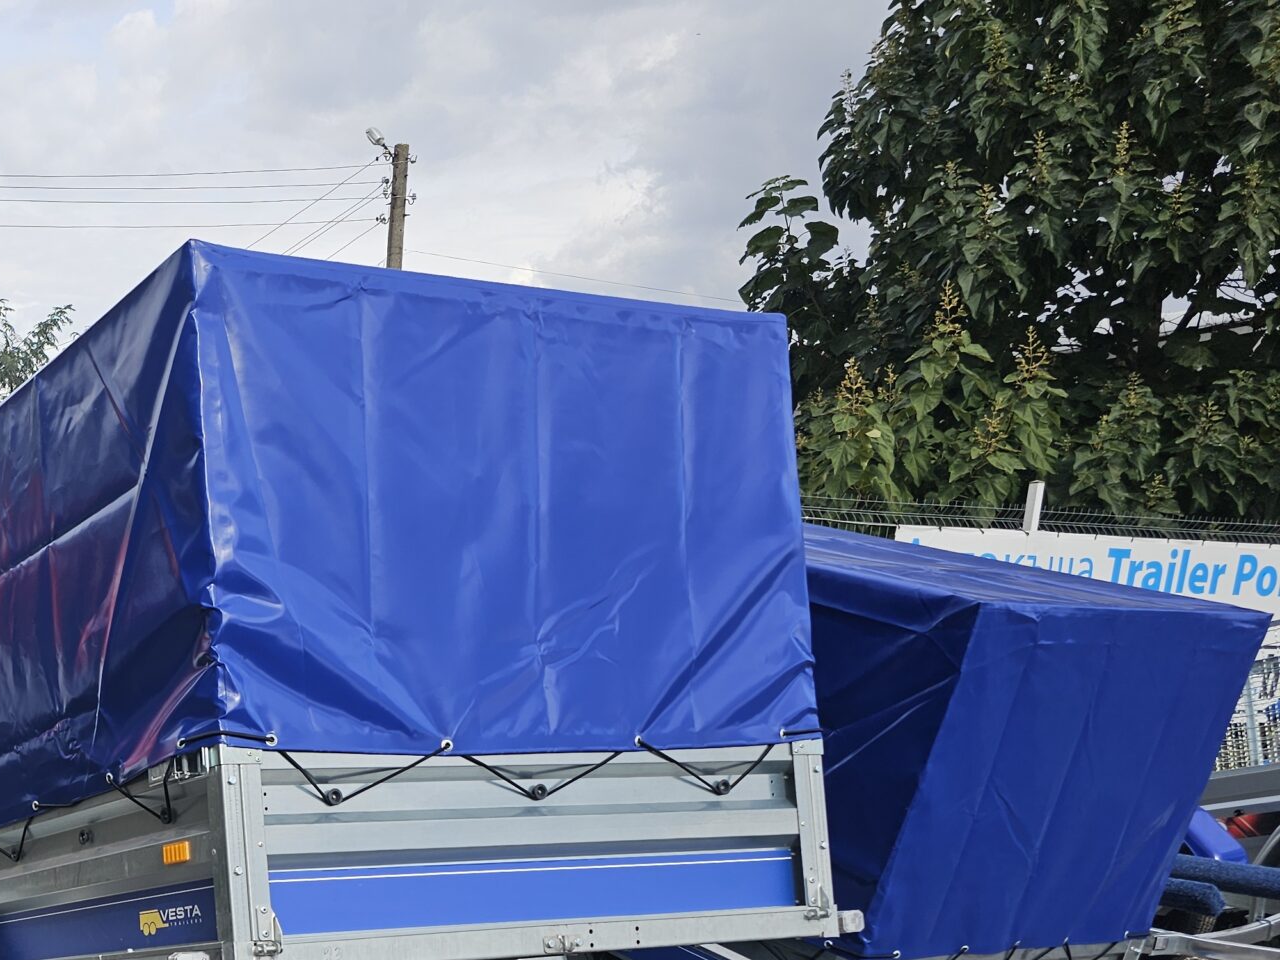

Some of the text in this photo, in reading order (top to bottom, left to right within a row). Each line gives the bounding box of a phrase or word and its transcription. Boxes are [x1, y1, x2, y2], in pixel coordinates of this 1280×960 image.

[1107, 547, 1228, 595] Trailer
[1231, 553, 1280, 598] Po
[160, 904, 202, 922] VESTA
